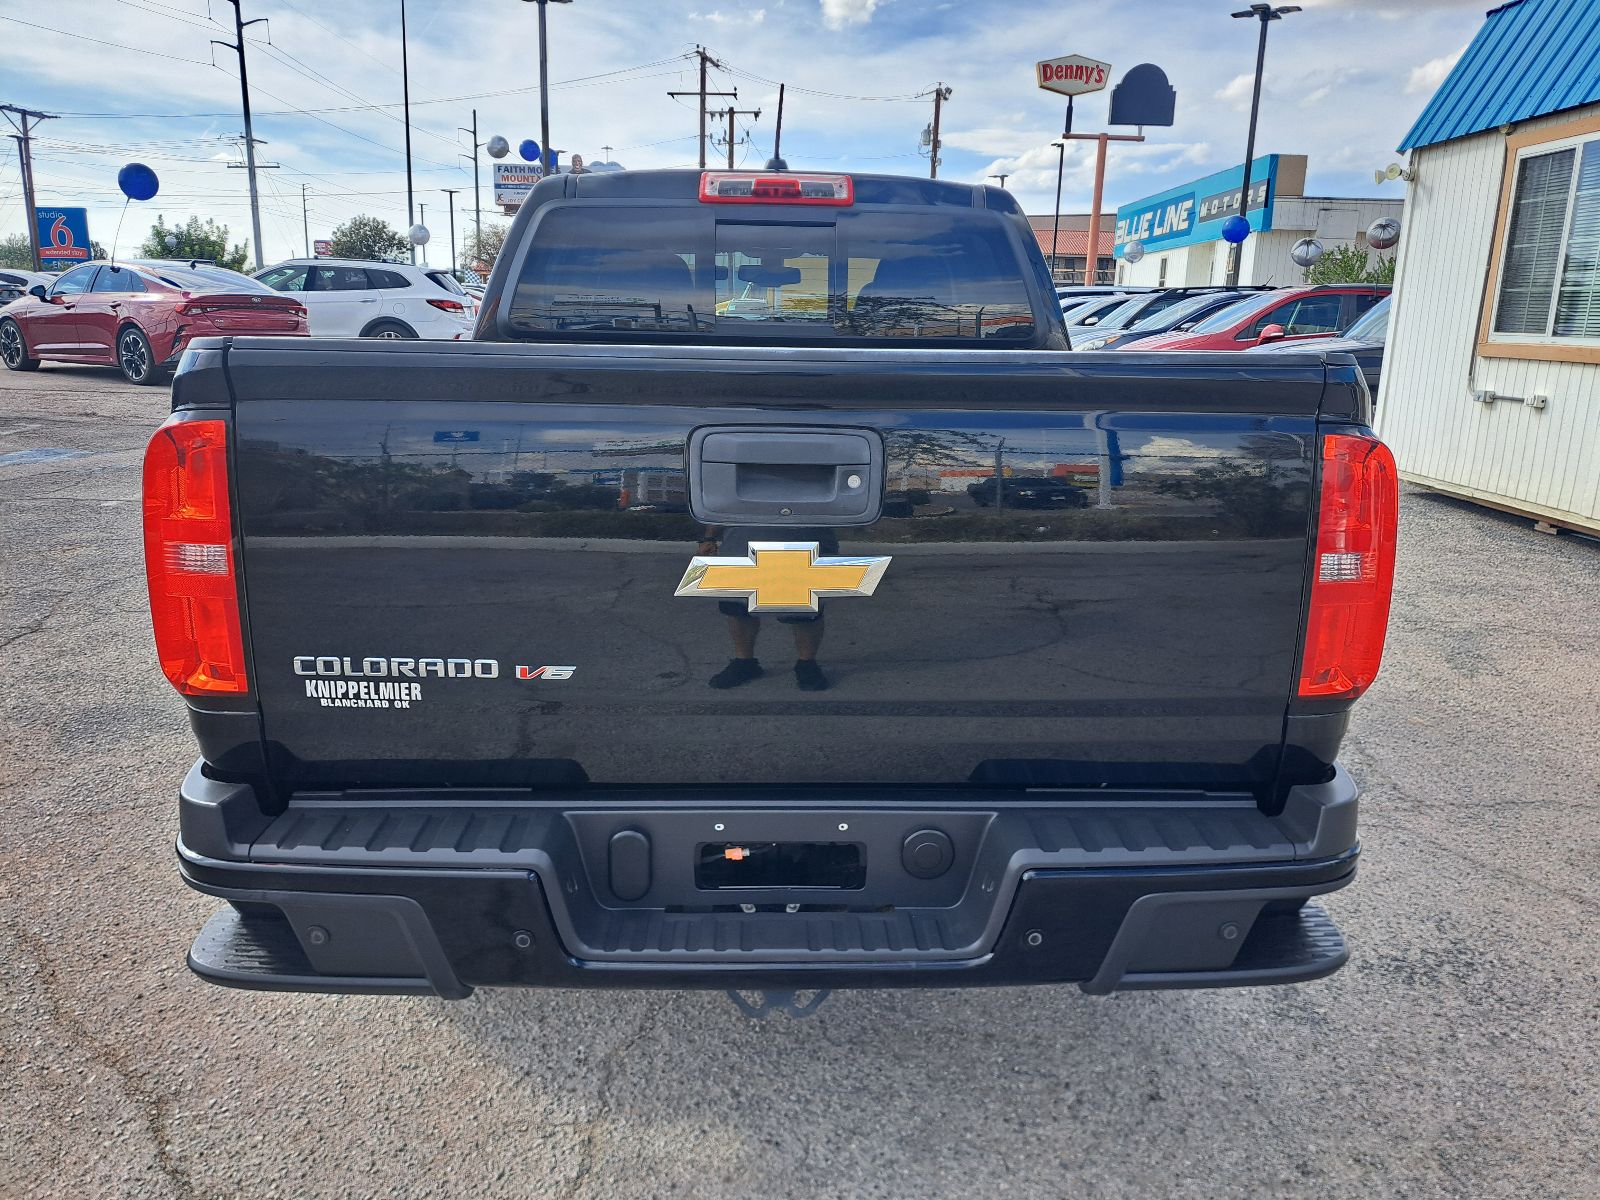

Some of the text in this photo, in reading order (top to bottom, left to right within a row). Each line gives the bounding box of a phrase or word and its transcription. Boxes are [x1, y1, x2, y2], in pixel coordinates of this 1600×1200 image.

[1042, 63, 1104, 84] Denny's
[497, 165, 526, 174] FAITH
[50, 216, 73, 248] 6
[1114, 199, 1194, 245] BLUE LINE
[71, 249, 83, 257] stay
[293, 656, 577, 680] COLORADO V6
[304, 679, 422, 701] KNIPPELMIER
[320, 698, 411, 709] BLANCHARD OK
